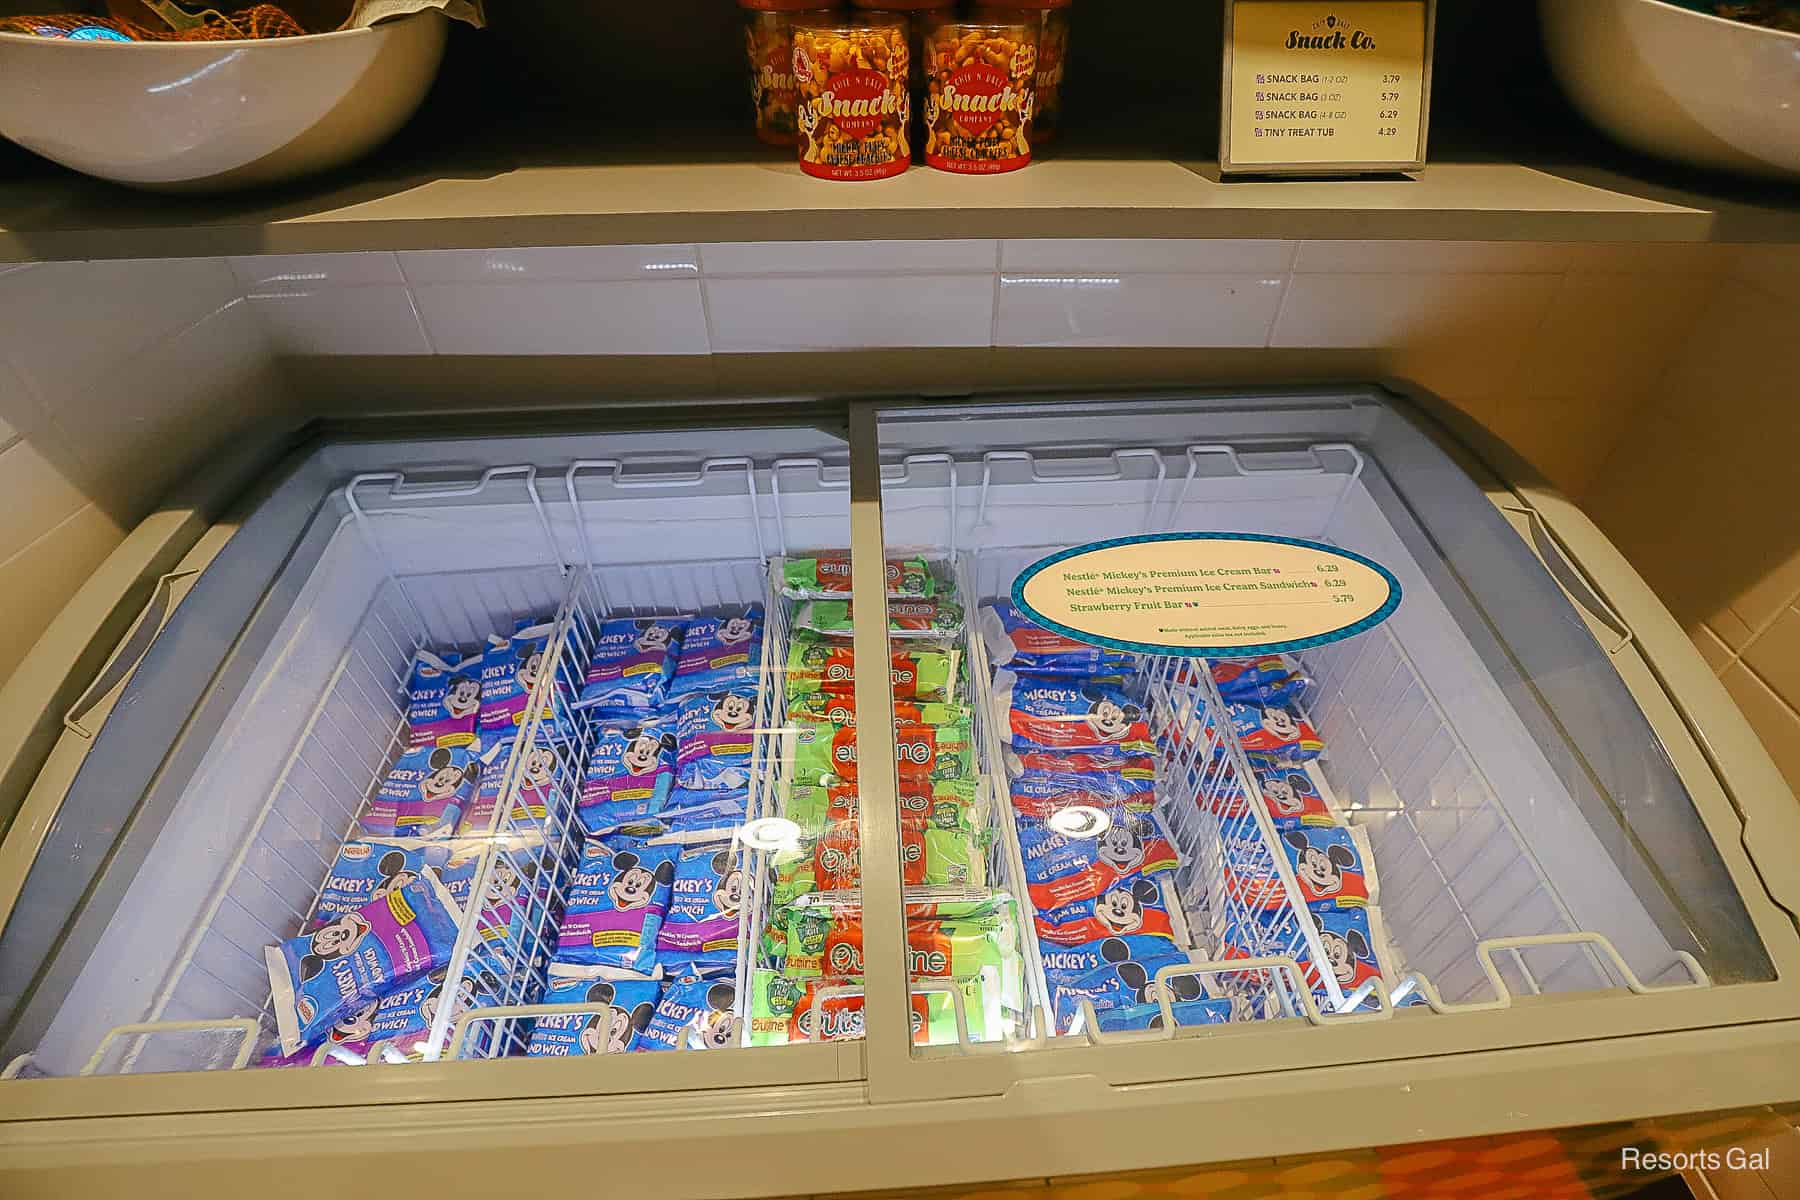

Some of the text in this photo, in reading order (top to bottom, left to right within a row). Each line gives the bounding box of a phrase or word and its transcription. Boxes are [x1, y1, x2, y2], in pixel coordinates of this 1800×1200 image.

[1285, 30, 1376, 50] Snack Co.
[1266, 74, 1298, 84] SNACK
[1300, 74, 1319, 83] BAG
[1382, 74, 1400, 84] 3.79
[819, 88, 896, 117] Snack
[940, 85, 1017, 112] Snack
[1266, 92, 1297, 102] SNACK
[1299, 92, 1318, 101] BAG
[1381, 92, 1399, 102] 5.79
[1265, 110, 1296, 119] SNACK
[1298, 110, 1317, 119] BAG
[1379, 110, 1398, 119] 6.29
[1264, 127, 1397, 137] TINY TREAT TUB 4.29
[1102, 570, 1147, 581] Mickey's
[1150, 569, 1198, 578] Premium
[1199, 568, 1216, 577] Ice
[1217, 567, 1252, 576] Cream
[1253, 566, 1273, 575] Bar
[1316, 564, 1339, 573] 6.29
[1106, 585, 1152, 596] Mickey's
[1154, 584, 1203, 593] Premium
[1205, 583, 1221, 592] Ice
[1222, 581, 1258, 591] Cream
[1259, 579, 1312, 590] Sandwich
[1324, 579, 1347, 587] 6.29
[1070, 594, 1354, 613] Strawberry Fruit Bar 5.79
[411, 687, 446, 701] CKEY'S
[1024, 688, 1078, 702] MICKEY'S
[388, 768, 425, 784] CKEY'S
[326, 875, 375, 893] ICKEY'S
[573, 872, 611, 887] CKEY'S
[673, 878, 713, 894] CKEY'S
[1042, 952, 1099, 969] MICKEY'S
[379, 988, 425, 1010] CKEY'S
[374, 1018, 409, 1031] DWICH
[534, 1014, 584, 1031] ICKEY'S
